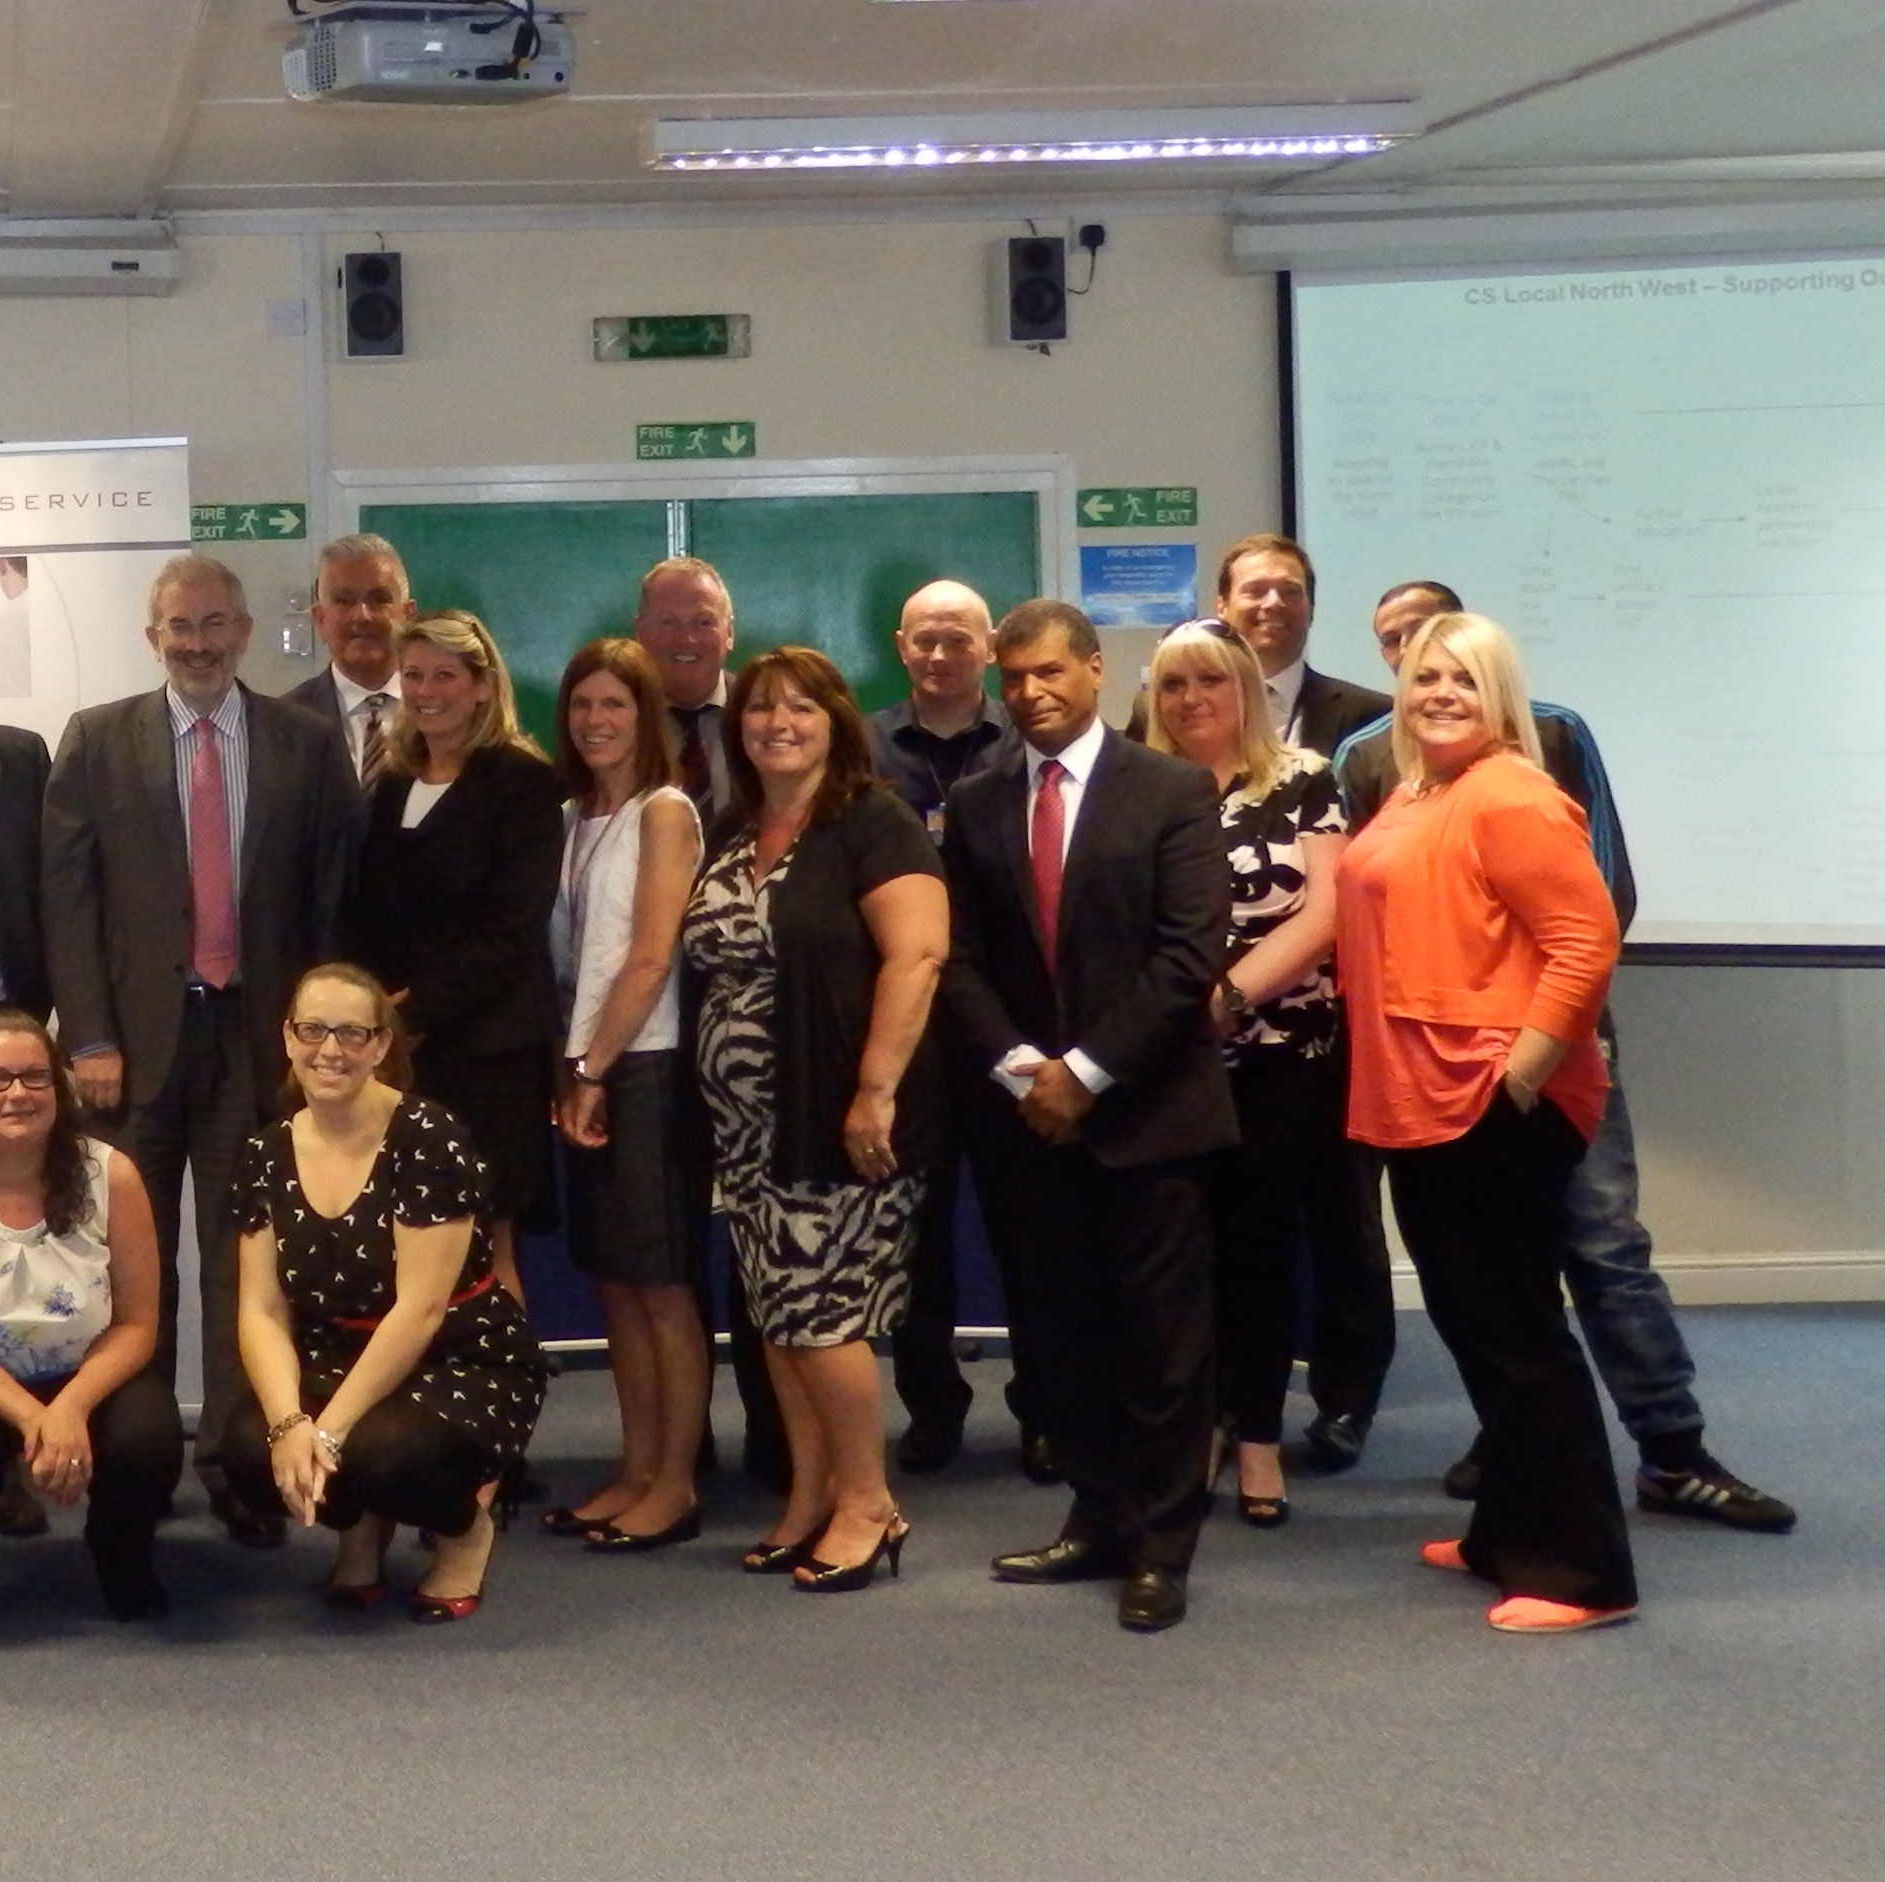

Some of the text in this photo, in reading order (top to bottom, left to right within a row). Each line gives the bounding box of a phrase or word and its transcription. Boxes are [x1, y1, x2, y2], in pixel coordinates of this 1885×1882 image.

[1464, 287, 1497, 304] CS
[1504, 284, 1564, 303] Local
[1569, 281, 1634, 300] North
[1638, 278, 1698, 297] West
[1722, 271, 1856, 296] Supporting
[639, 426, 675, 439] FIRE
[639, 444, 674, 457] EXIT
[1155, 490, 1192, 503] FIRE
[191, 507, 226, 521] FIRE
[1155, 509, 1192, 523] EXIT
[191, 525, 226, 539] EXIT
